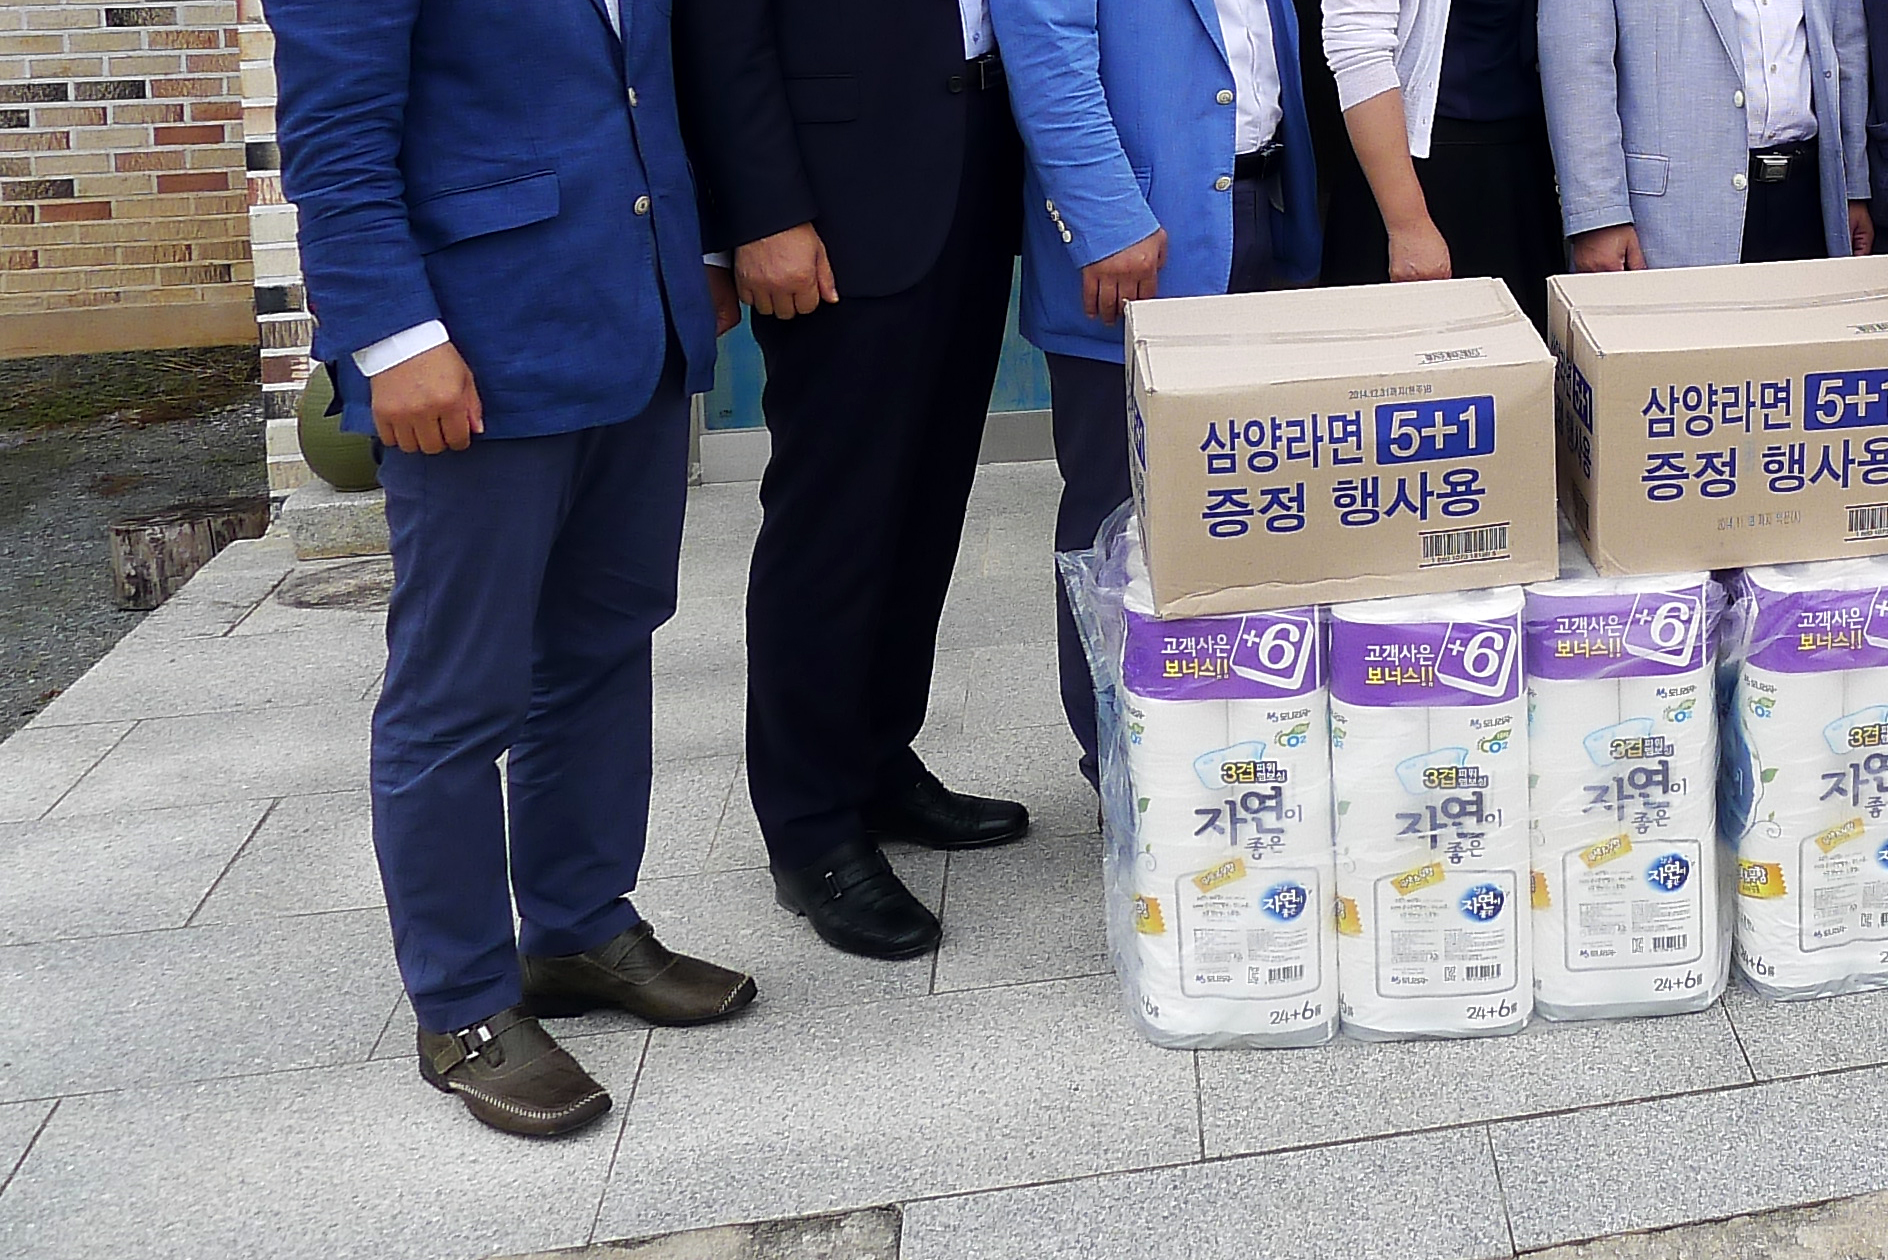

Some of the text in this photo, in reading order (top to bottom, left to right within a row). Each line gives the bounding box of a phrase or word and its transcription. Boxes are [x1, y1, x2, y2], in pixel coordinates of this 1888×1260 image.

[1641, 378, 1791, 439] 삼양라면
[1199, 404, 1479, 474] 삼양라면 5+1
[1641, 446, 1737, 502] 증정
[1201, 468, 1486, 539] 증정 행사용
[1554, 615, 1623, 638] 고객사은
[1797, 608, 1864, 630] 고객사은
[1161, 634, 1231, 657] 고객사은
[1555, 638, 1622, 658] 보너스!!
[1797, 630, 1862, 650] 보너스!!
[1364, 644, 1435, 665] 고객사은
[1162, 659, 1229, 679] 보너스!!
[1365, 667, 1434, 687] 보너스!!
[1849, 725, 1880, 747] 3겹
[1610, 738, 1644, 759] 3겹
[1222, 763, 1255, 783] 3겹
[1424, 768, 1457, 788] 3겹
